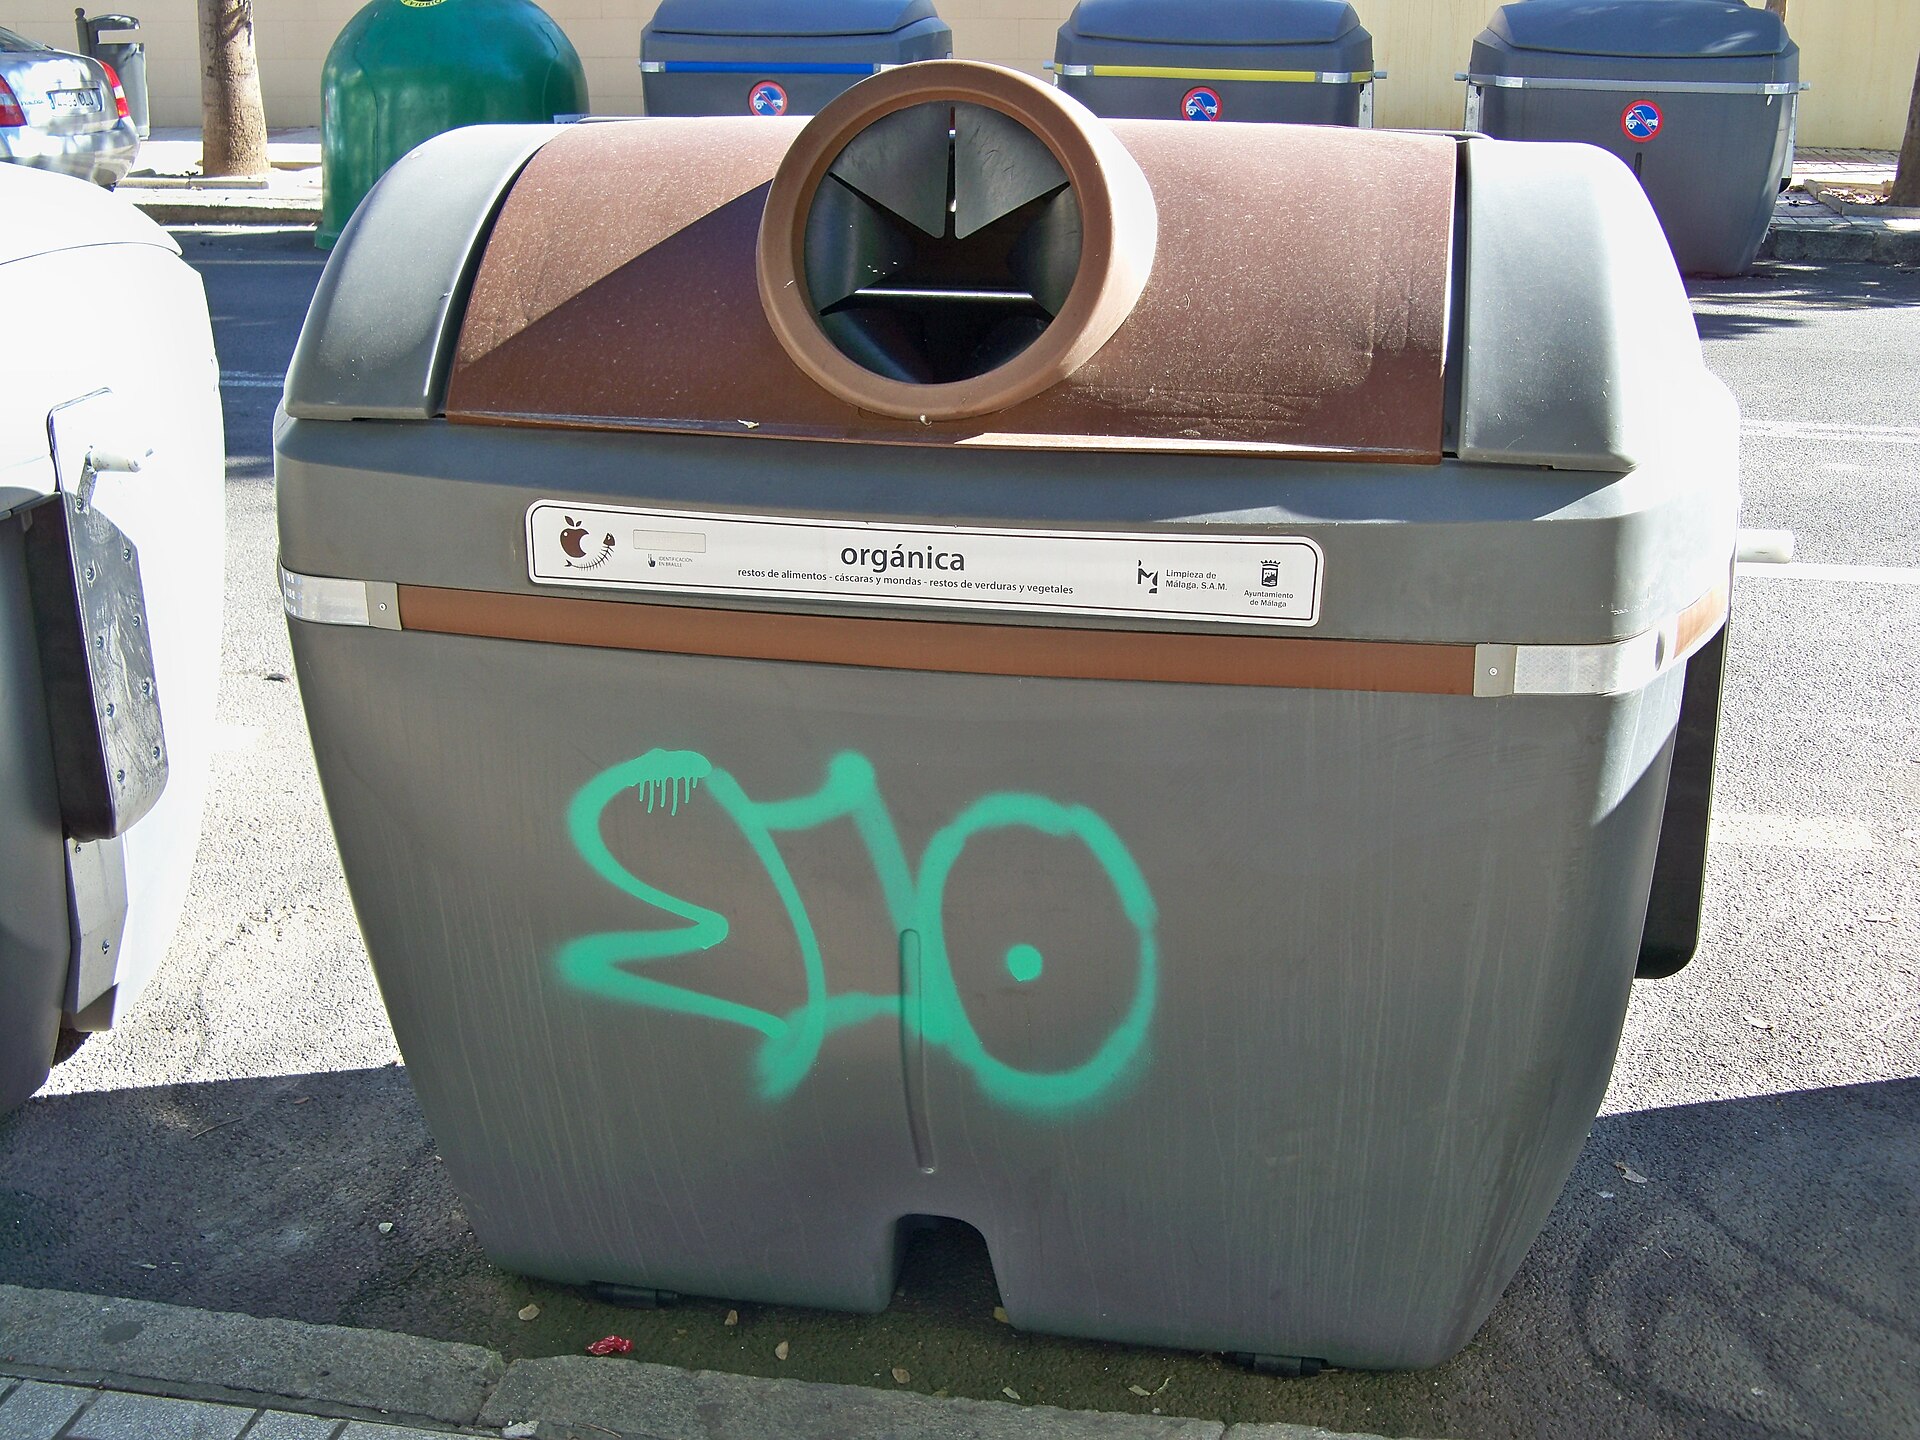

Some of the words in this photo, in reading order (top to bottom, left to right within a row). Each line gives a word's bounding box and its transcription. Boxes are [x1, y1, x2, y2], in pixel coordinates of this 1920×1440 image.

[840, 543, 965, 573] orgánica
[1166, 569, 1204, 580] Limpieza
[1205, 571, 1217, 580] de
[737, 568, 766, 578] restos
[767, 569, 779, 579] de
[781, 570, 827, 581] alimentos
[834, 573, 874, 584] cáscaras
[875, 577, 882, 586] y
[883, 576, 922, 586] mondas
[929, 579, 958, 589] restos
[960, 579, 973, 589] de
[975, 581, 1017, 591] verduras
[1018, 584, 1026, 593] y
[1027, 584, 1074, 595] vegetales
[1200, 582, 1228, 591] S.A.M.
[1243, 590, 1294, 599] Ayuntamiento
[1260, 599, 1287, 608] Málaga
